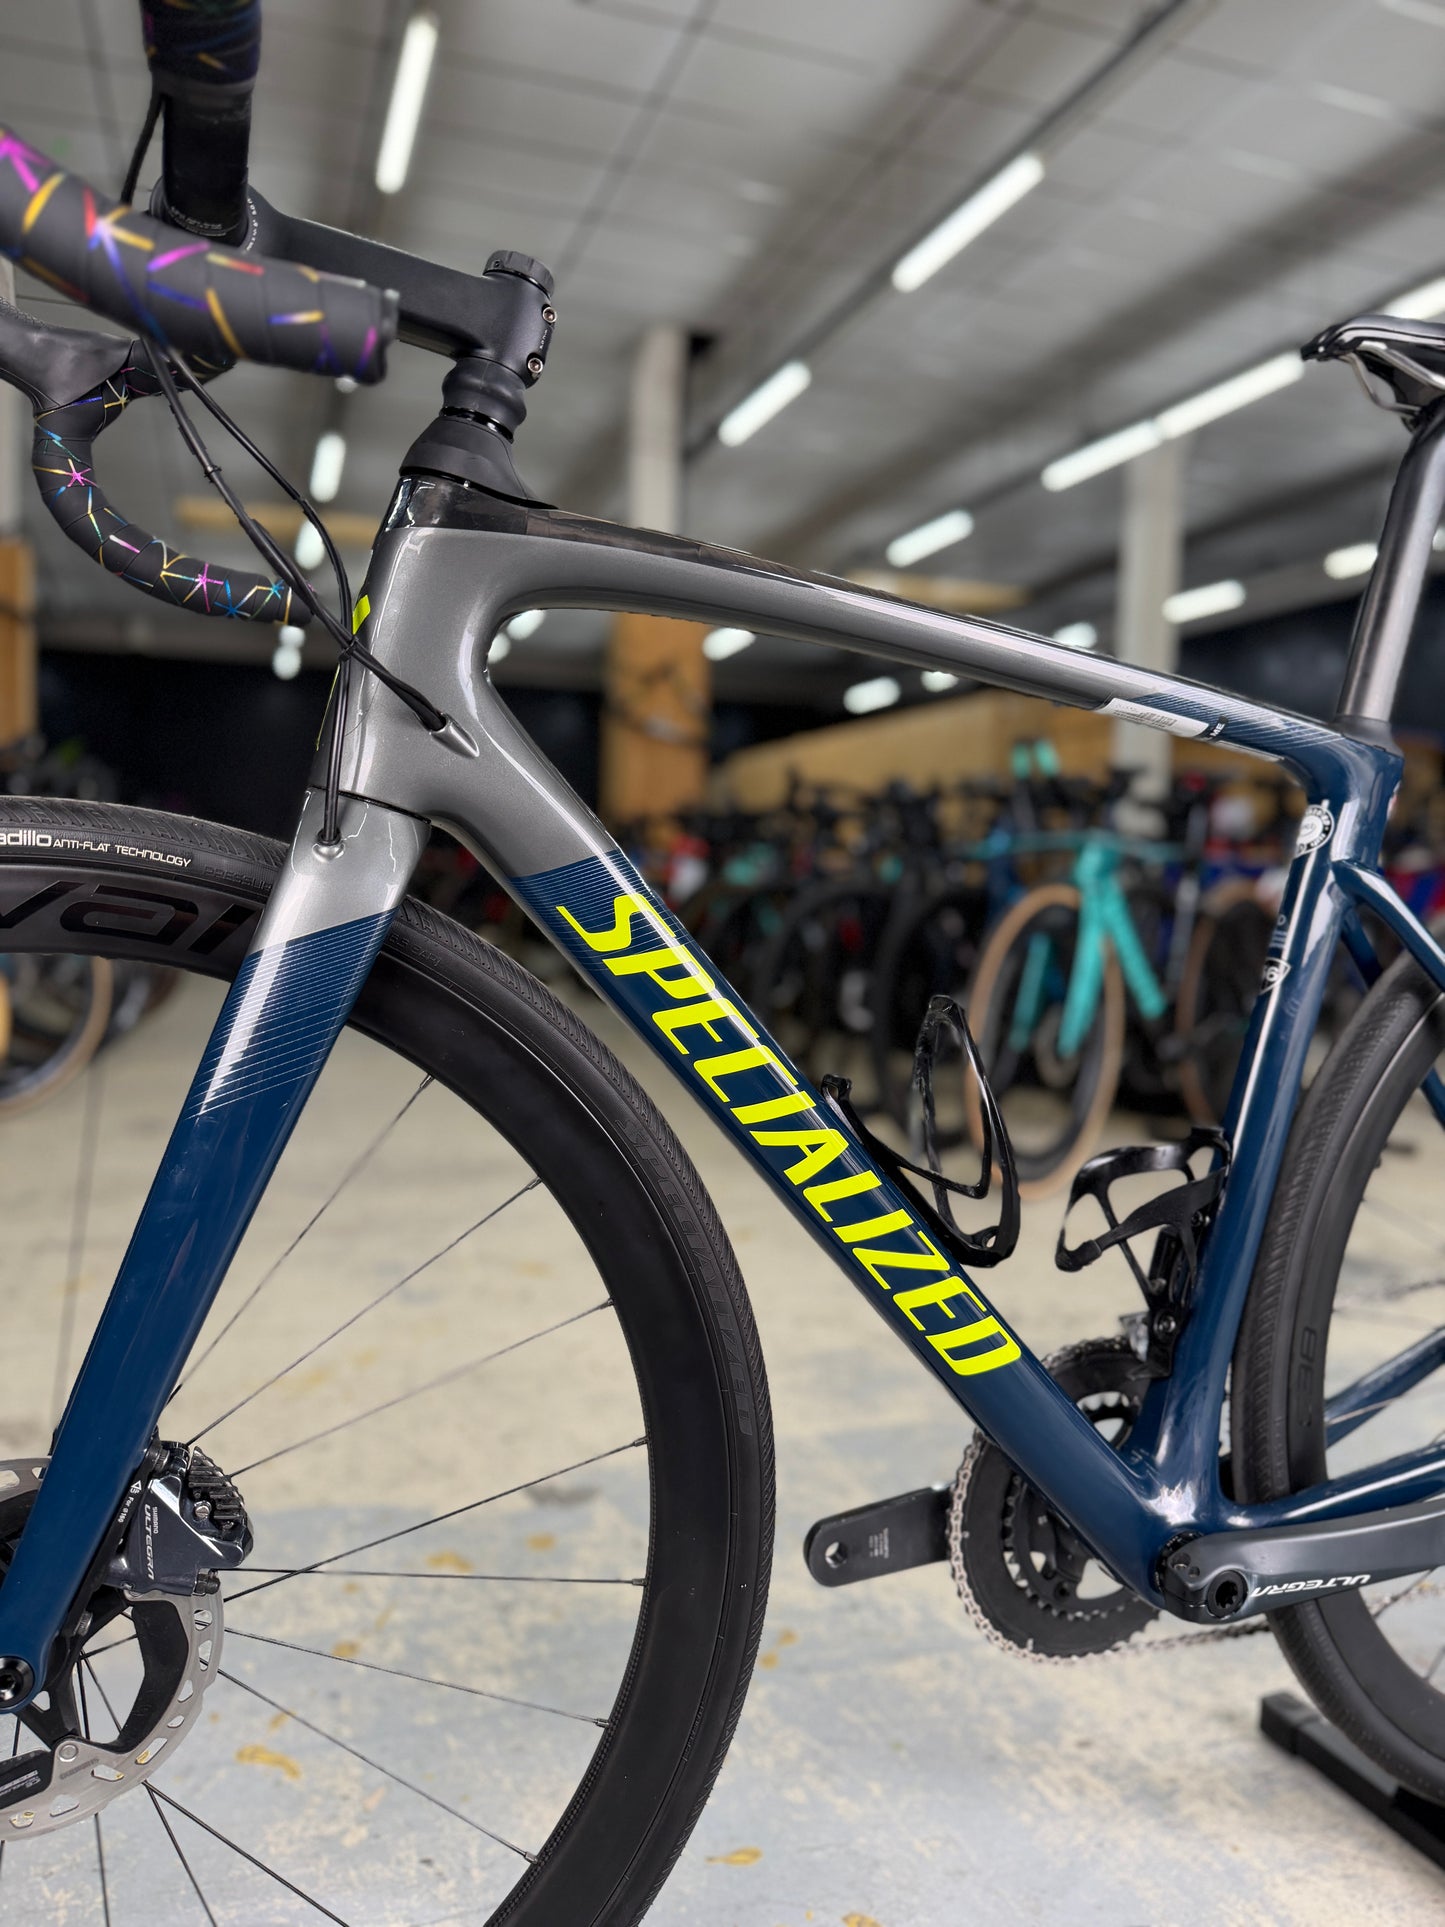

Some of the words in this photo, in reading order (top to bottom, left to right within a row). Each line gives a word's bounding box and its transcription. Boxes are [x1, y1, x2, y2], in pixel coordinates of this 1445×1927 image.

[53, 838, 111, 853] ANTI-FLAT
[115, 844, 193, 868] TECHNOLOGY
[556, 892, 1022, 1376] SPECIALIZED
[144, 1503, 155, 1581] ULTEGRA
[1250, 1573, 1371, 1598] ULTEGRA
